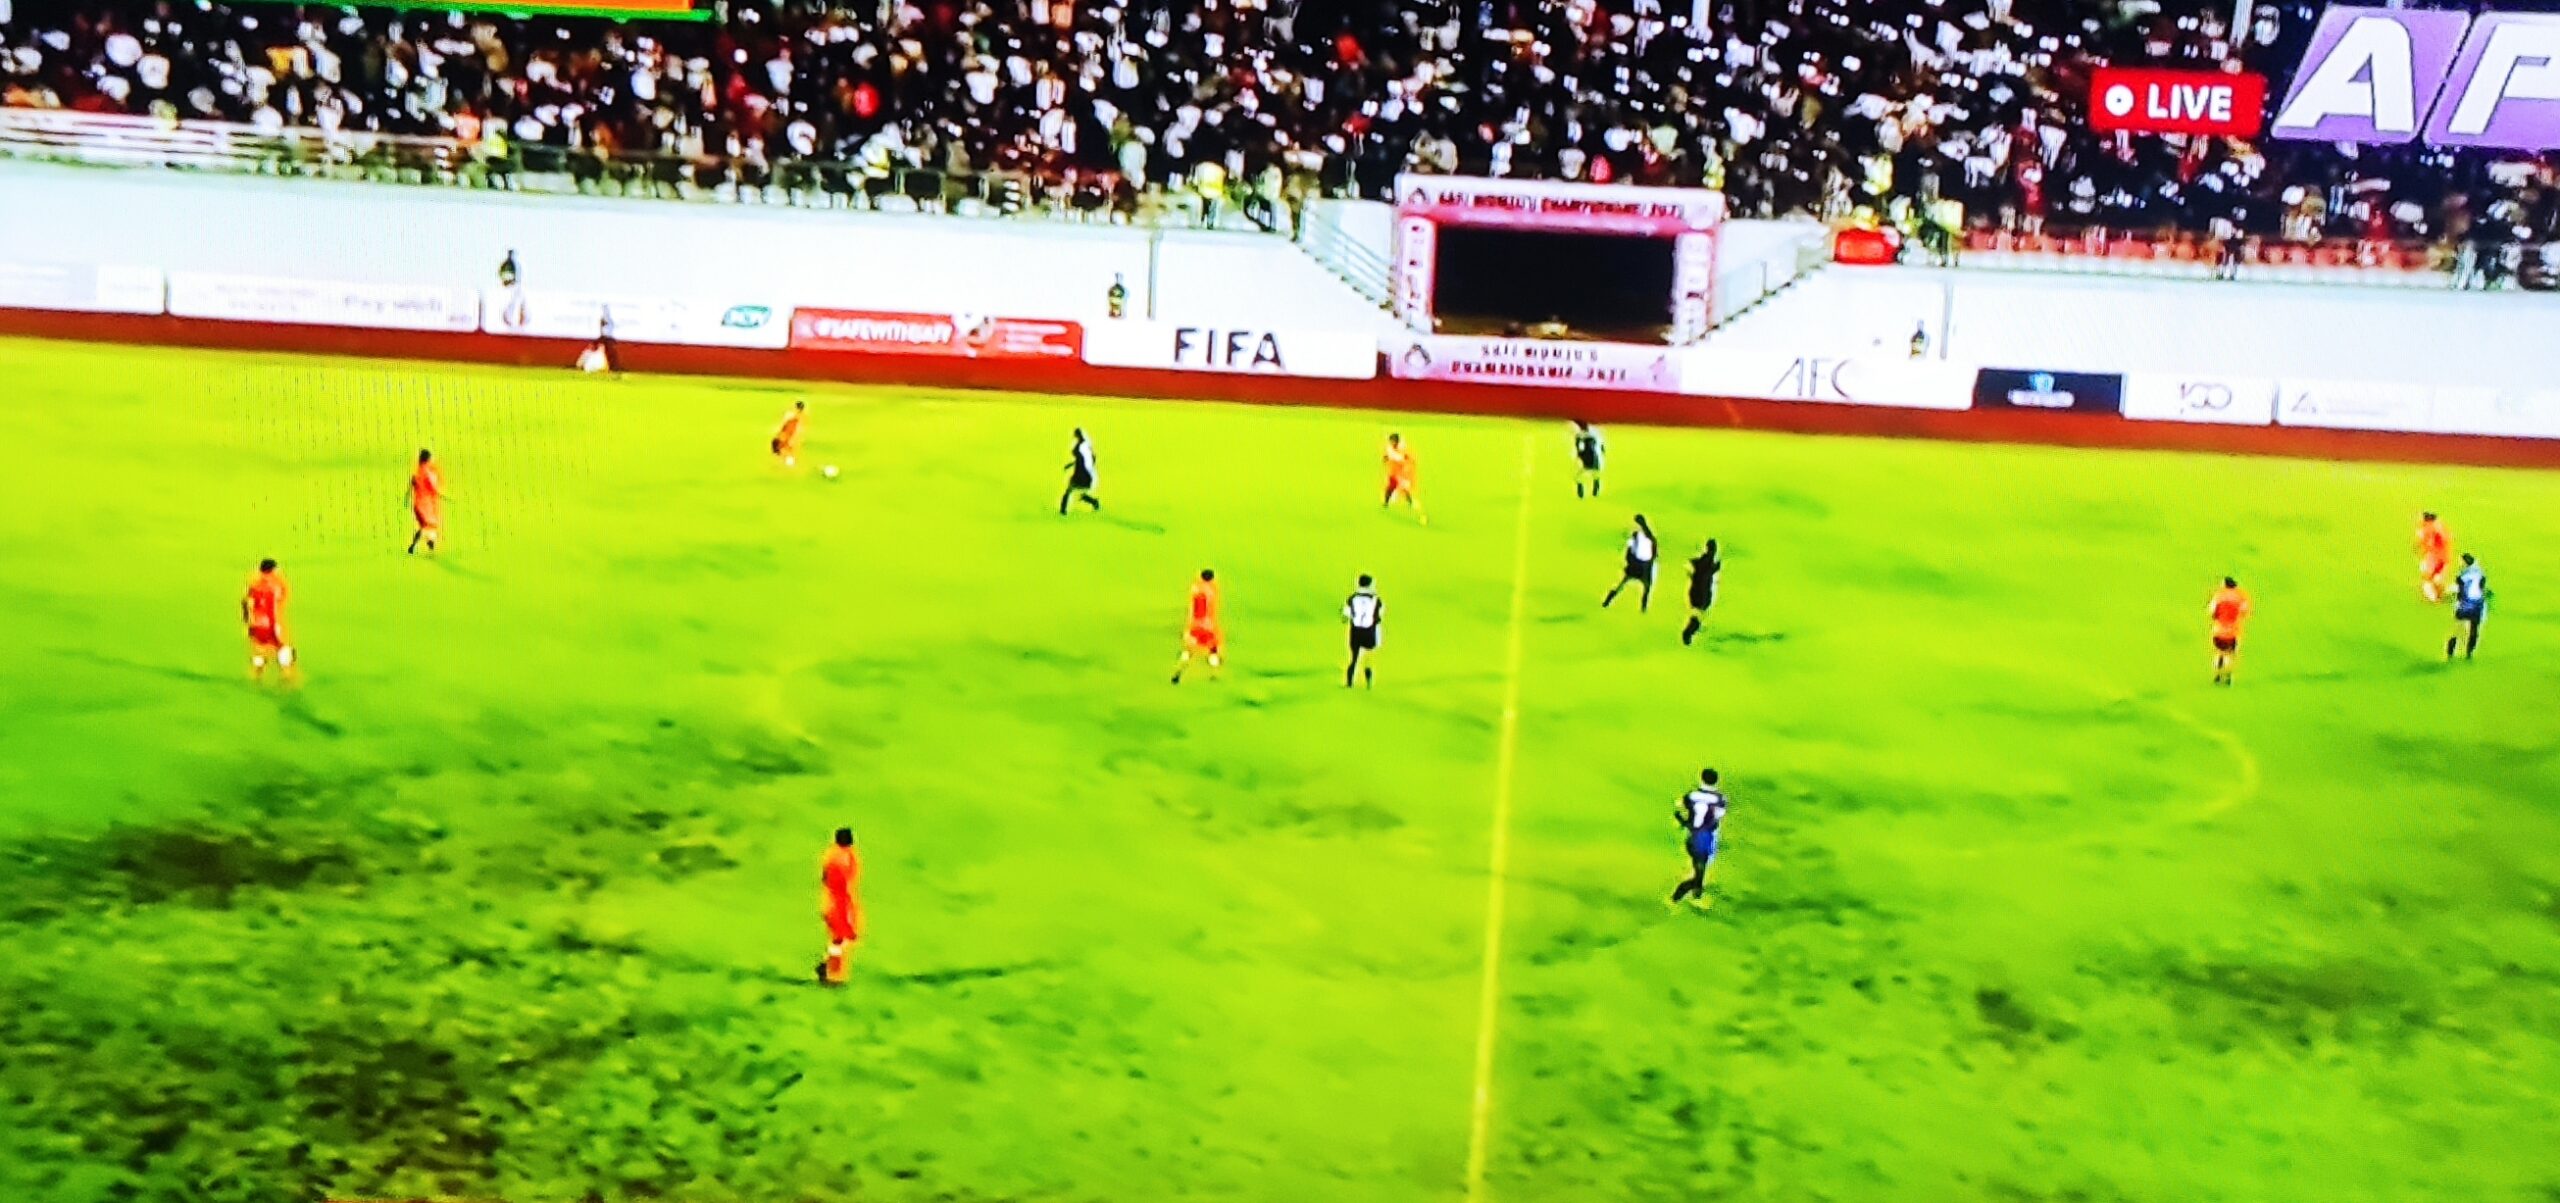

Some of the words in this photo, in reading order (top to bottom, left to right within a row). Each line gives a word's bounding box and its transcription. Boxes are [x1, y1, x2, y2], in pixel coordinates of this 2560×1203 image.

[2147, 83, 2232, 121] LIVE
[1174, 328, 1284, 368] FIFA
[1772, 358, 1852, 399] AFC
